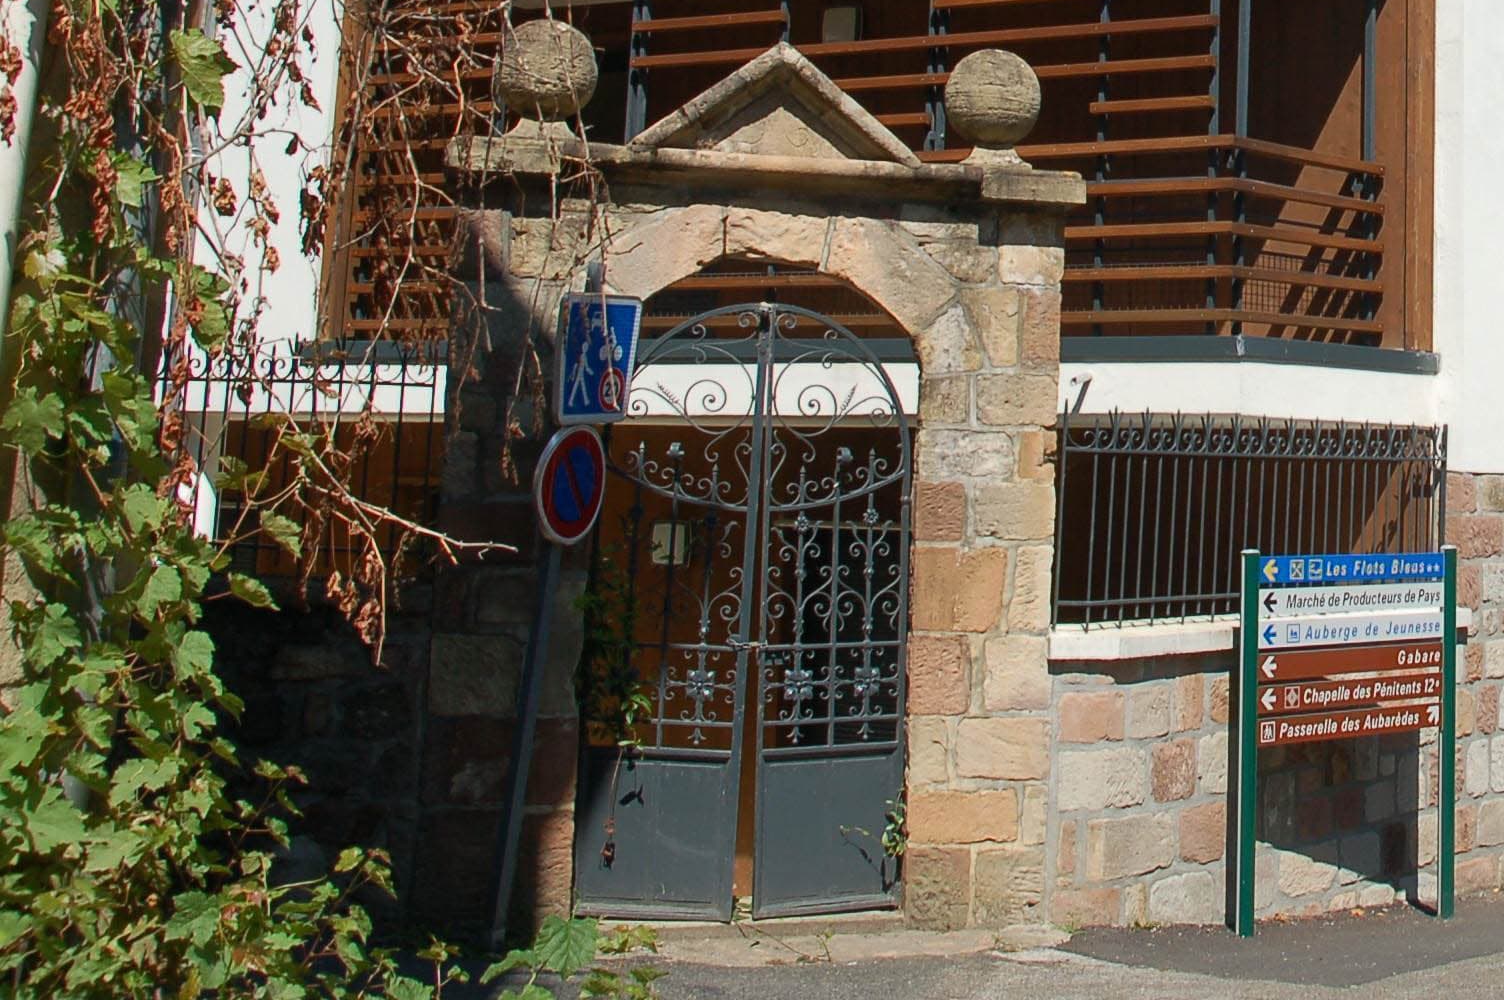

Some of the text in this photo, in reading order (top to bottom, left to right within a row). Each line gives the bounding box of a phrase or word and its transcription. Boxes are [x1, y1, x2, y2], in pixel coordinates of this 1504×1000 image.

[1326, 559, 1425, 577] Les Flots Bleus
[1286, 588, 1440, 609] Marché de Producteurs de Pays
[1305, 621, 1440, 641] Auberge de Jeunesse
[1397, 648, 1441, 665] Gabare
[1303, 685, 1351, 707] Chapelle
[1352, 684, 1372, 700] des
[1373, 680, 1422, 698] Pénitents
[1279, 718, 1338, 739] Passerelle
[1341, 717, 1361, 733] des
